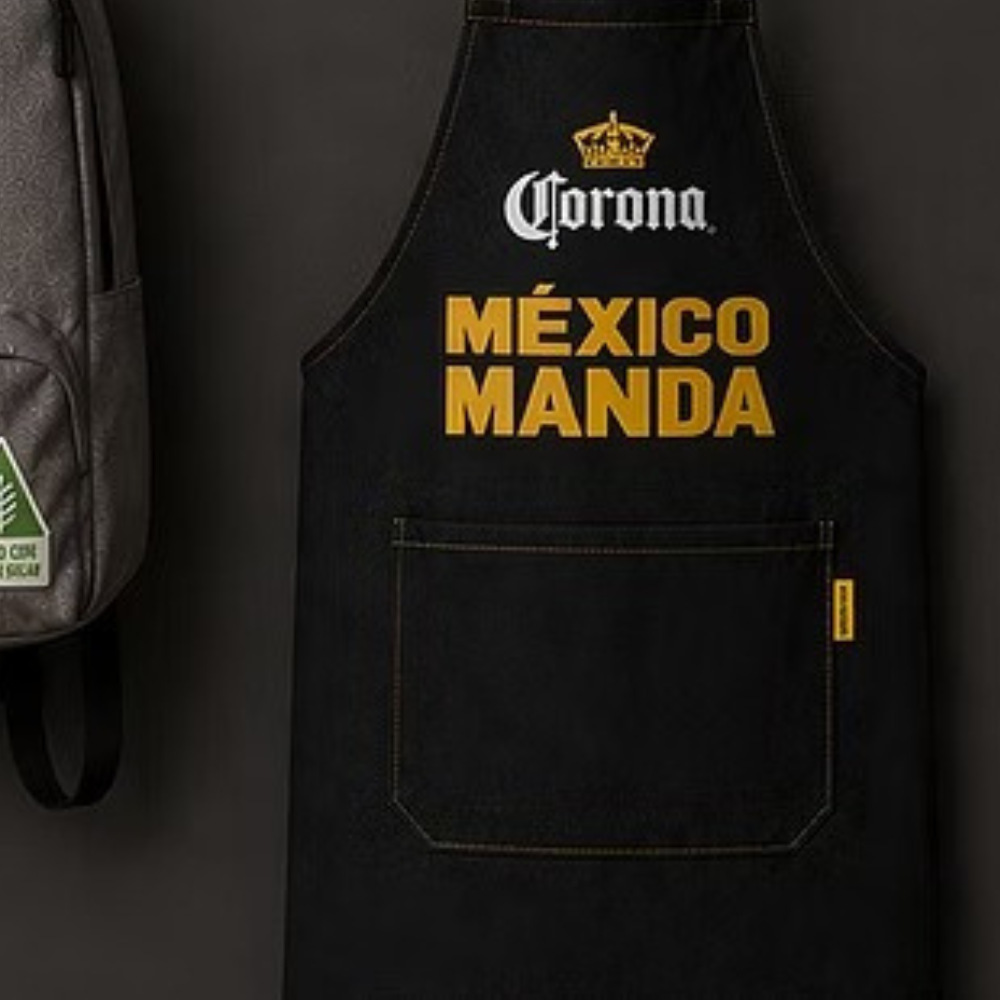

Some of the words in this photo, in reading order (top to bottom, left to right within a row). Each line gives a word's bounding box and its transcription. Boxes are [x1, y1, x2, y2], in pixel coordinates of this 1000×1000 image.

[504, 170, 707, 250] Corona
[445, 283, 769, 357] MÉXICO
[445, 365, 775, 437] MANDA
